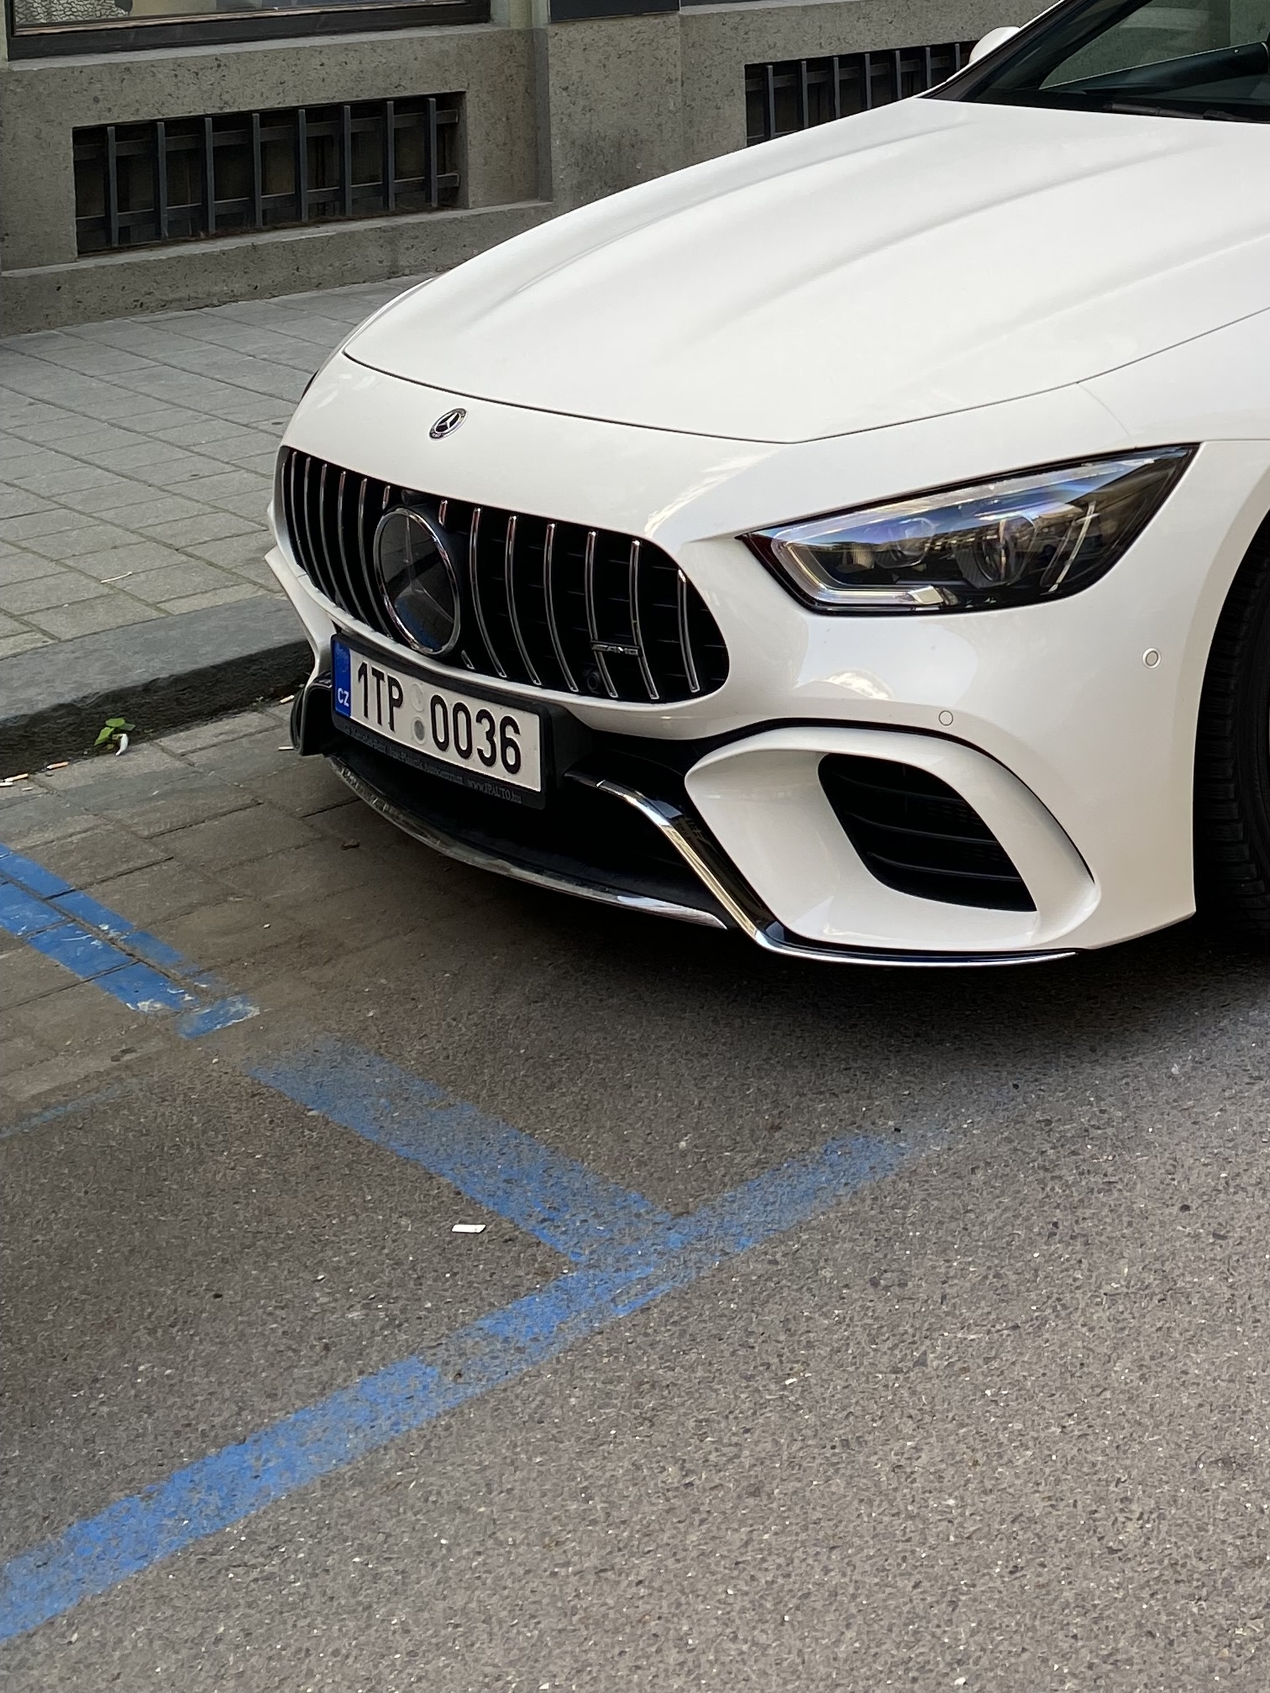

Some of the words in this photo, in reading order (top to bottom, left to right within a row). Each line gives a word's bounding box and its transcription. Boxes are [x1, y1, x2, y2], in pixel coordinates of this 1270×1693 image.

[337, 688, 349, 707] CZ
[357, 662, 404, 732] 1TP
[430, 694, 521, 775] 0036
